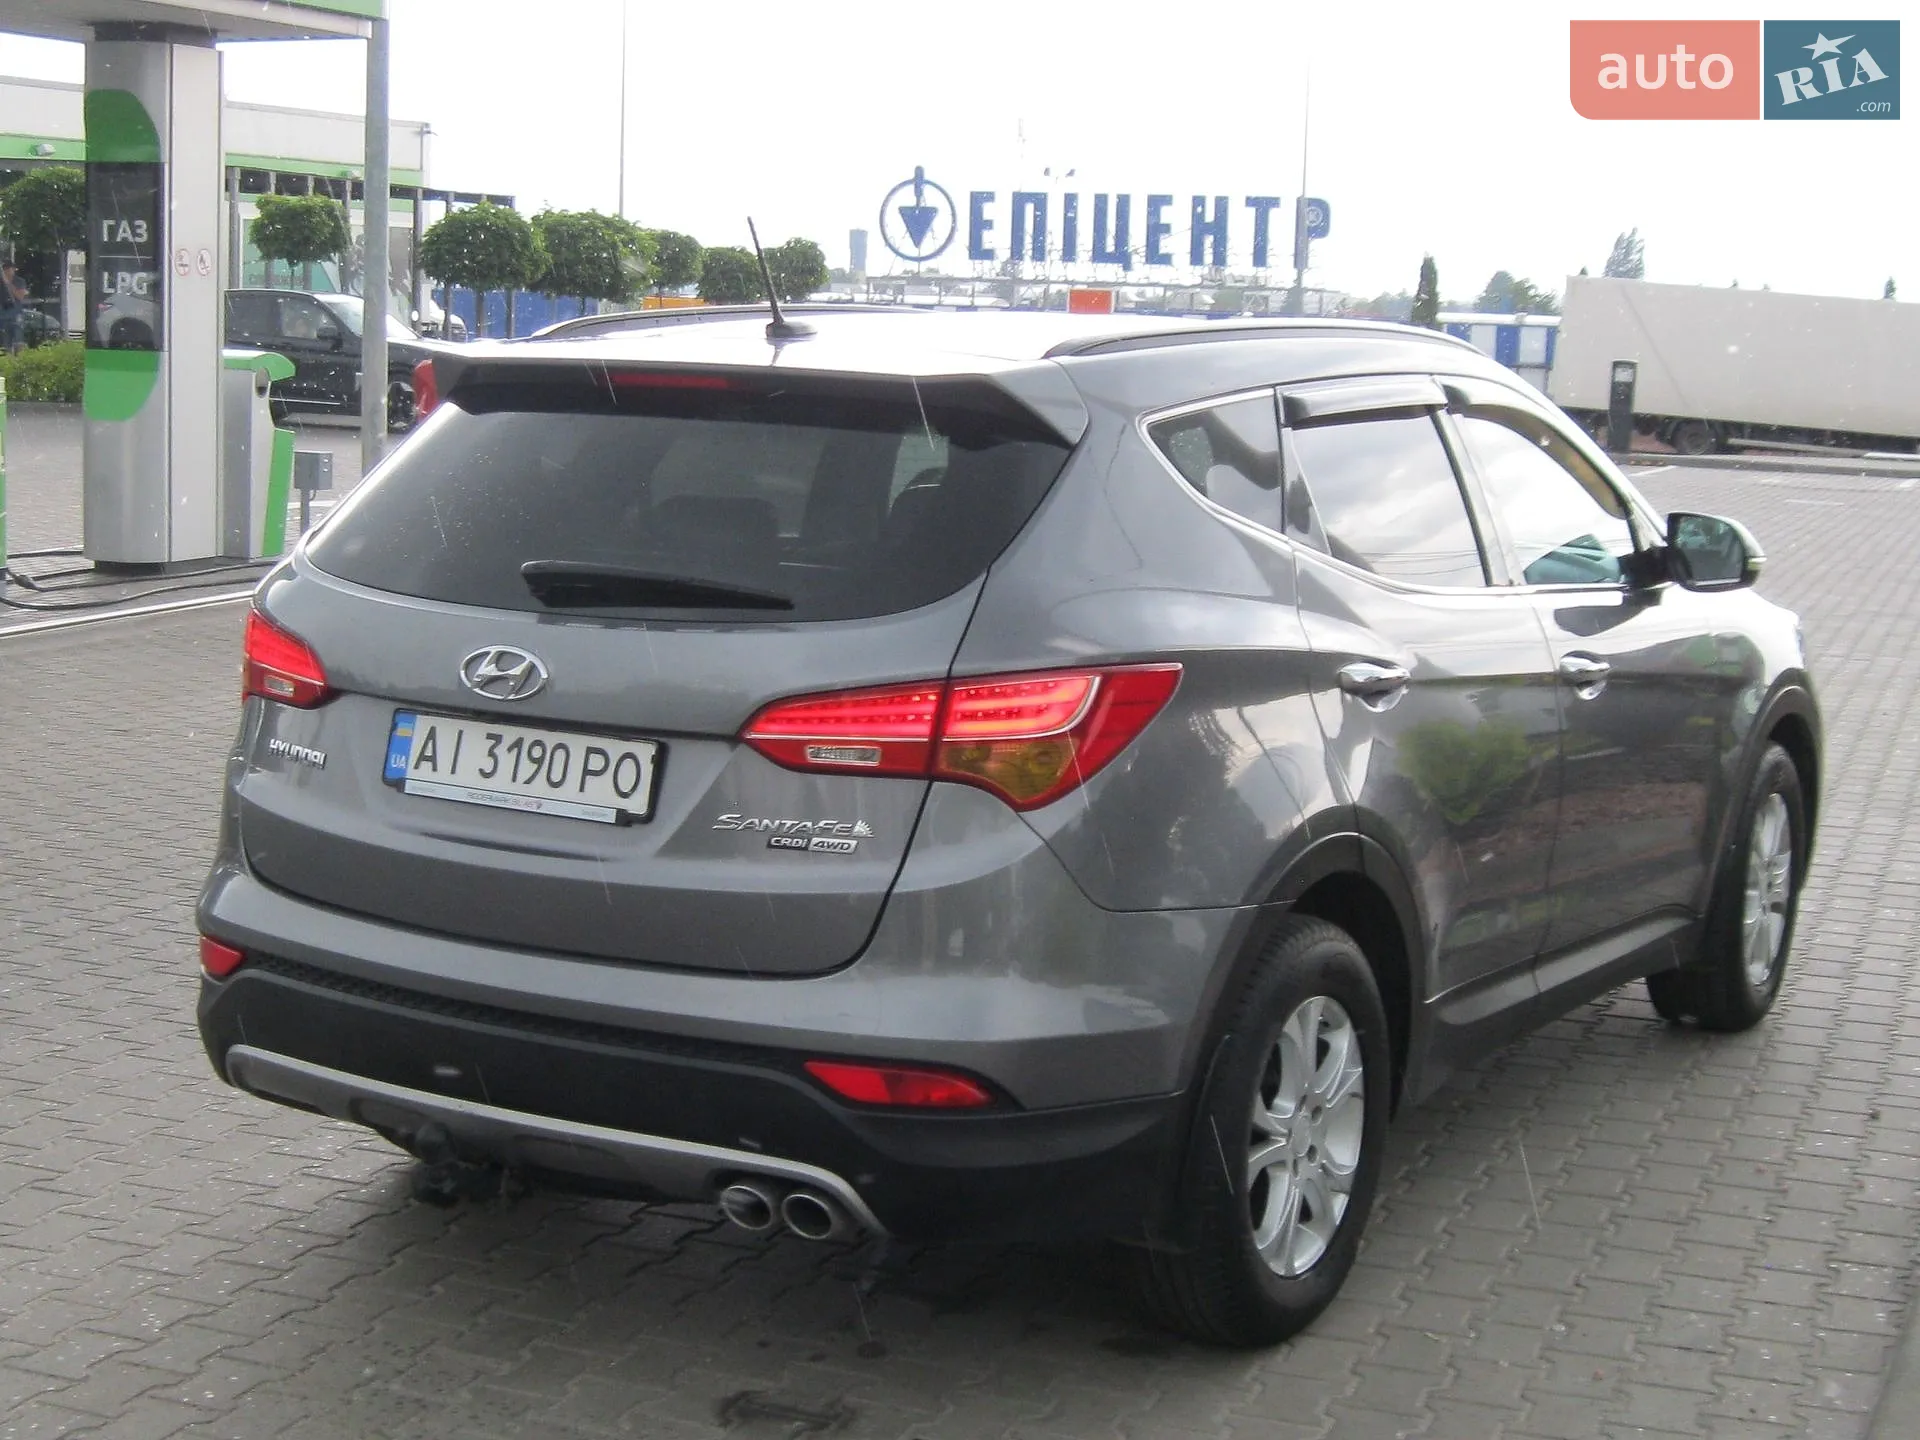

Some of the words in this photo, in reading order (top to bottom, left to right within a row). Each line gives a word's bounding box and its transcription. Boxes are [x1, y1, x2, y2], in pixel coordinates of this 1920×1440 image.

[102, 219, 148, 243] ГАЗ
[968, 190, 1331, 270] ЕПІЦЕНТР
[102, 271, 148, 295] LPG
[390, 753, 407, 769] UA
[413, 725, 464, 776] AI
[478, 732, 571, 789] 3190
[578, 745, 642, 800] PO
[812, 841, 852, 852] 4WD
